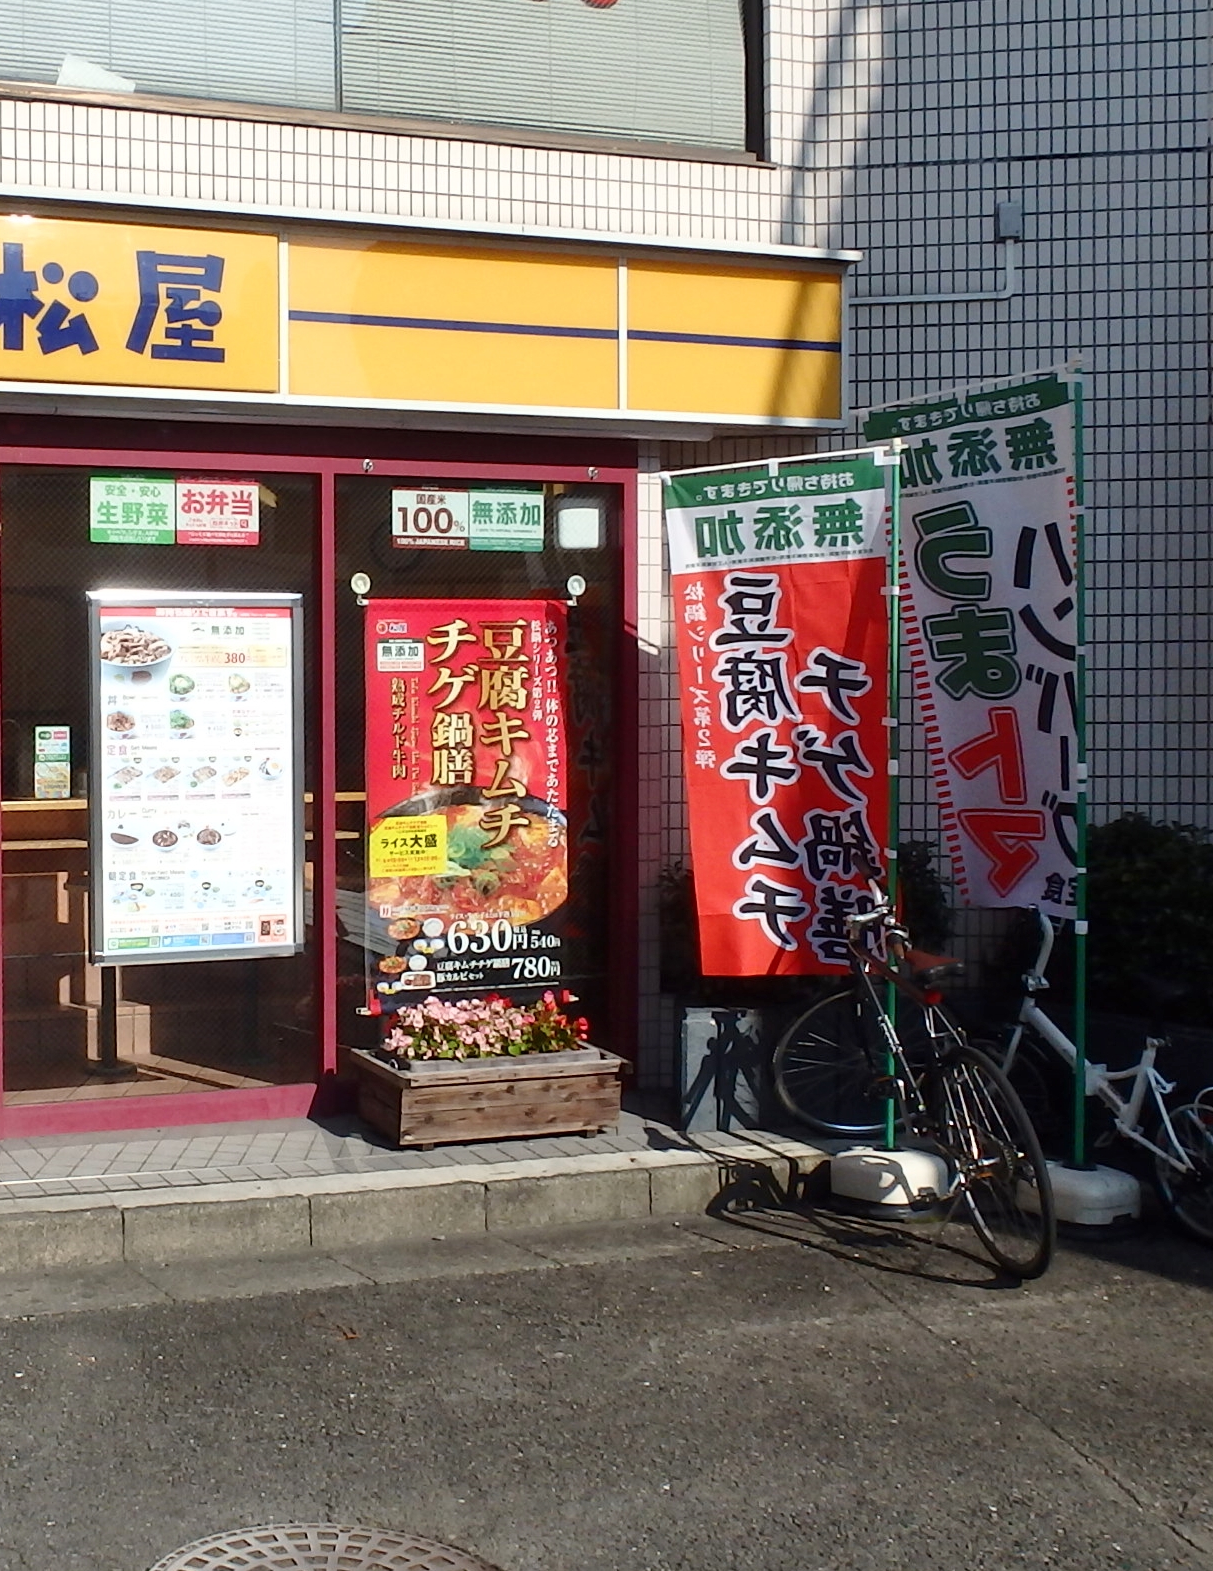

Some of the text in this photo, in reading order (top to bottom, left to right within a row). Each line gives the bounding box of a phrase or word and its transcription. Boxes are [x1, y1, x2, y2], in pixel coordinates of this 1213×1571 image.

[105, 484, 161, 497] 安全・安心
[416, 493, 447, 505] 国産米
[97, 501, 168, 526] 生野菜
[181, 489, 253, 516] お弁当
[472, 500, 541, 526] 無添加
[397, 507, 465, 534] 100%
[211, 626, 245, 635] 無添加
[382, 645, 419, 657] 無添加
[426, 619, 478, 785] チゲ鍋膳
[392, 677, 406, 779] 熟成チルド牛肉
[477, 619, 530, 848] 豆腐キムチ
[107, 745, 127, 755] 定食
[107, 809, 137, 819] カレー
[381, 834, 437, 848] ライス大盛
[448, 918, 528, 954] 630円
[530, 934, 561, 949] 540円
[511, 956, 561, 979] 780円
